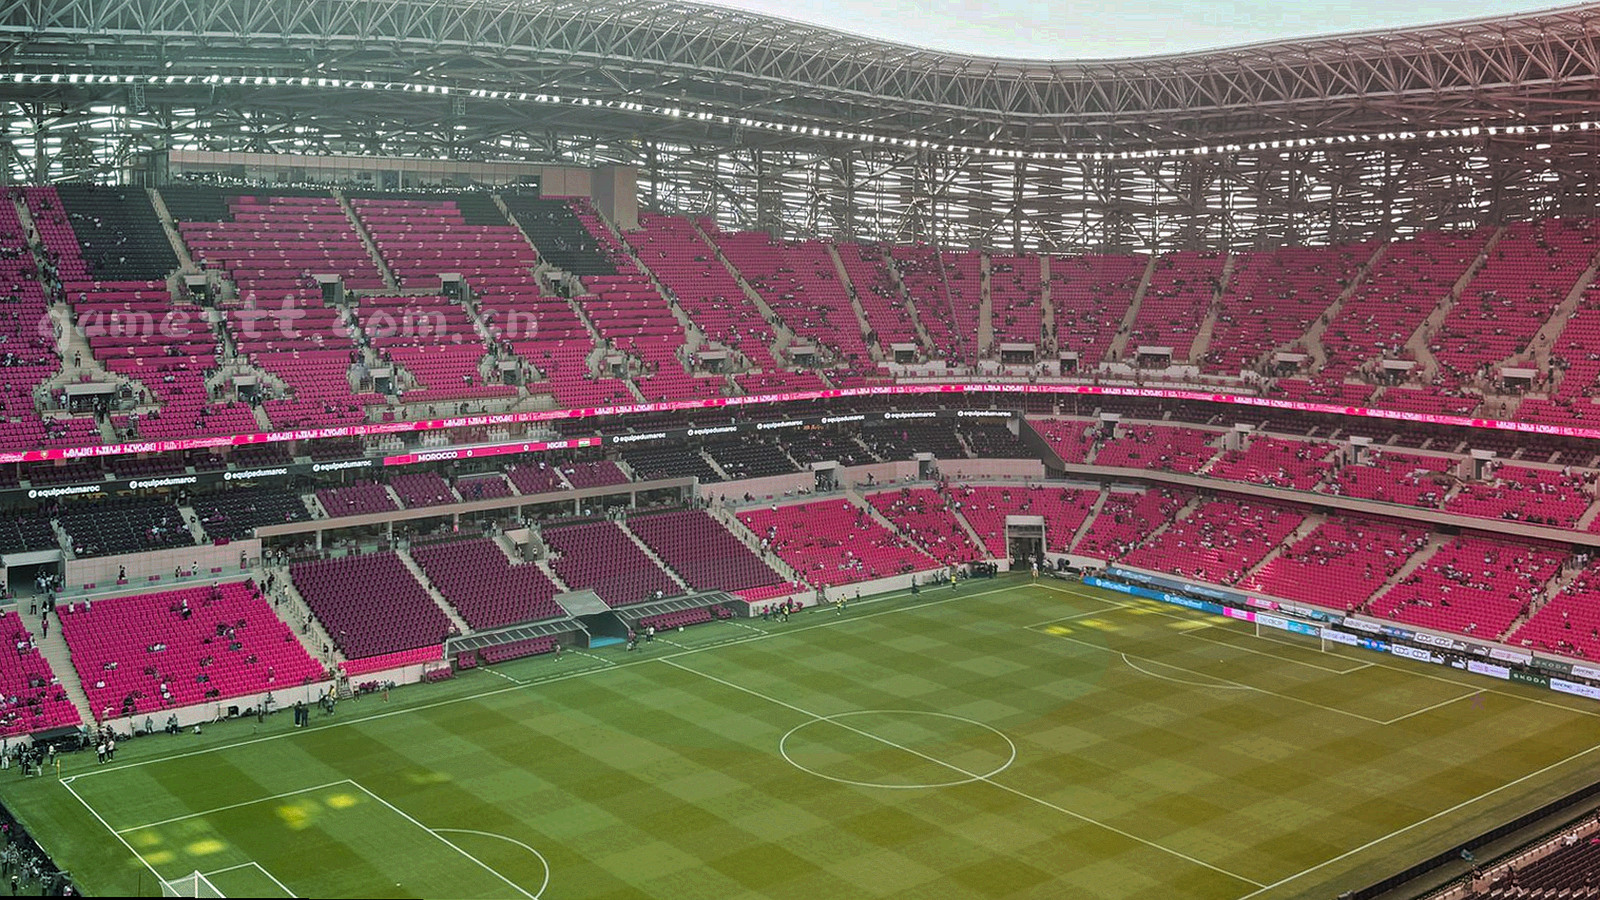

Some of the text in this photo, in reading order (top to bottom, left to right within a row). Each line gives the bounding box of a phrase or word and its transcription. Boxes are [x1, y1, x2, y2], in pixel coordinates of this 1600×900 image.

[418, 451, 458, 462] MOROCCO
[546, 440, 568, 450] NIGER
[320, 460, 372, 472] equipedumaroc
[232, 468, 288, 481] equipedumaroc
[137, 476, 197, 489] equipedumaroc
[37, 485, 100, 498] equipedumaroc
